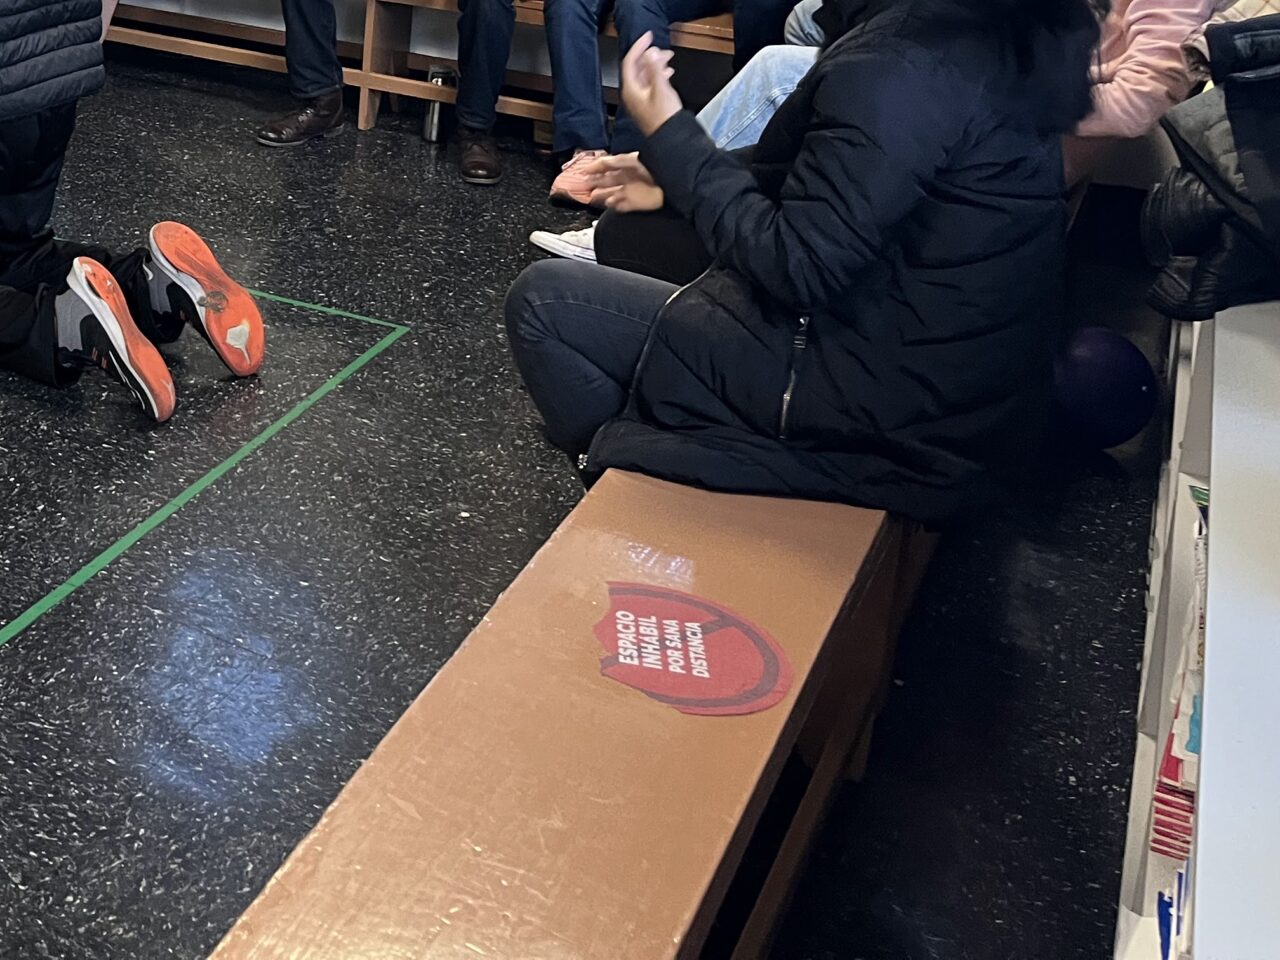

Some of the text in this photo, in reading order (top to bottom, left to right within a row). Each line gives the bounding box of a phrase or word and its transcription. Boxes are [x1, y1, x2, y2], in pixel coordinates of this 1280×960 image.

[615, 610, 640, 666] ESPACIO
[637, 615, 663, 670] INHABIL
[662, 619, 687, 674] POR SANA
[684, 622, 710, 678] DISTANCIA
